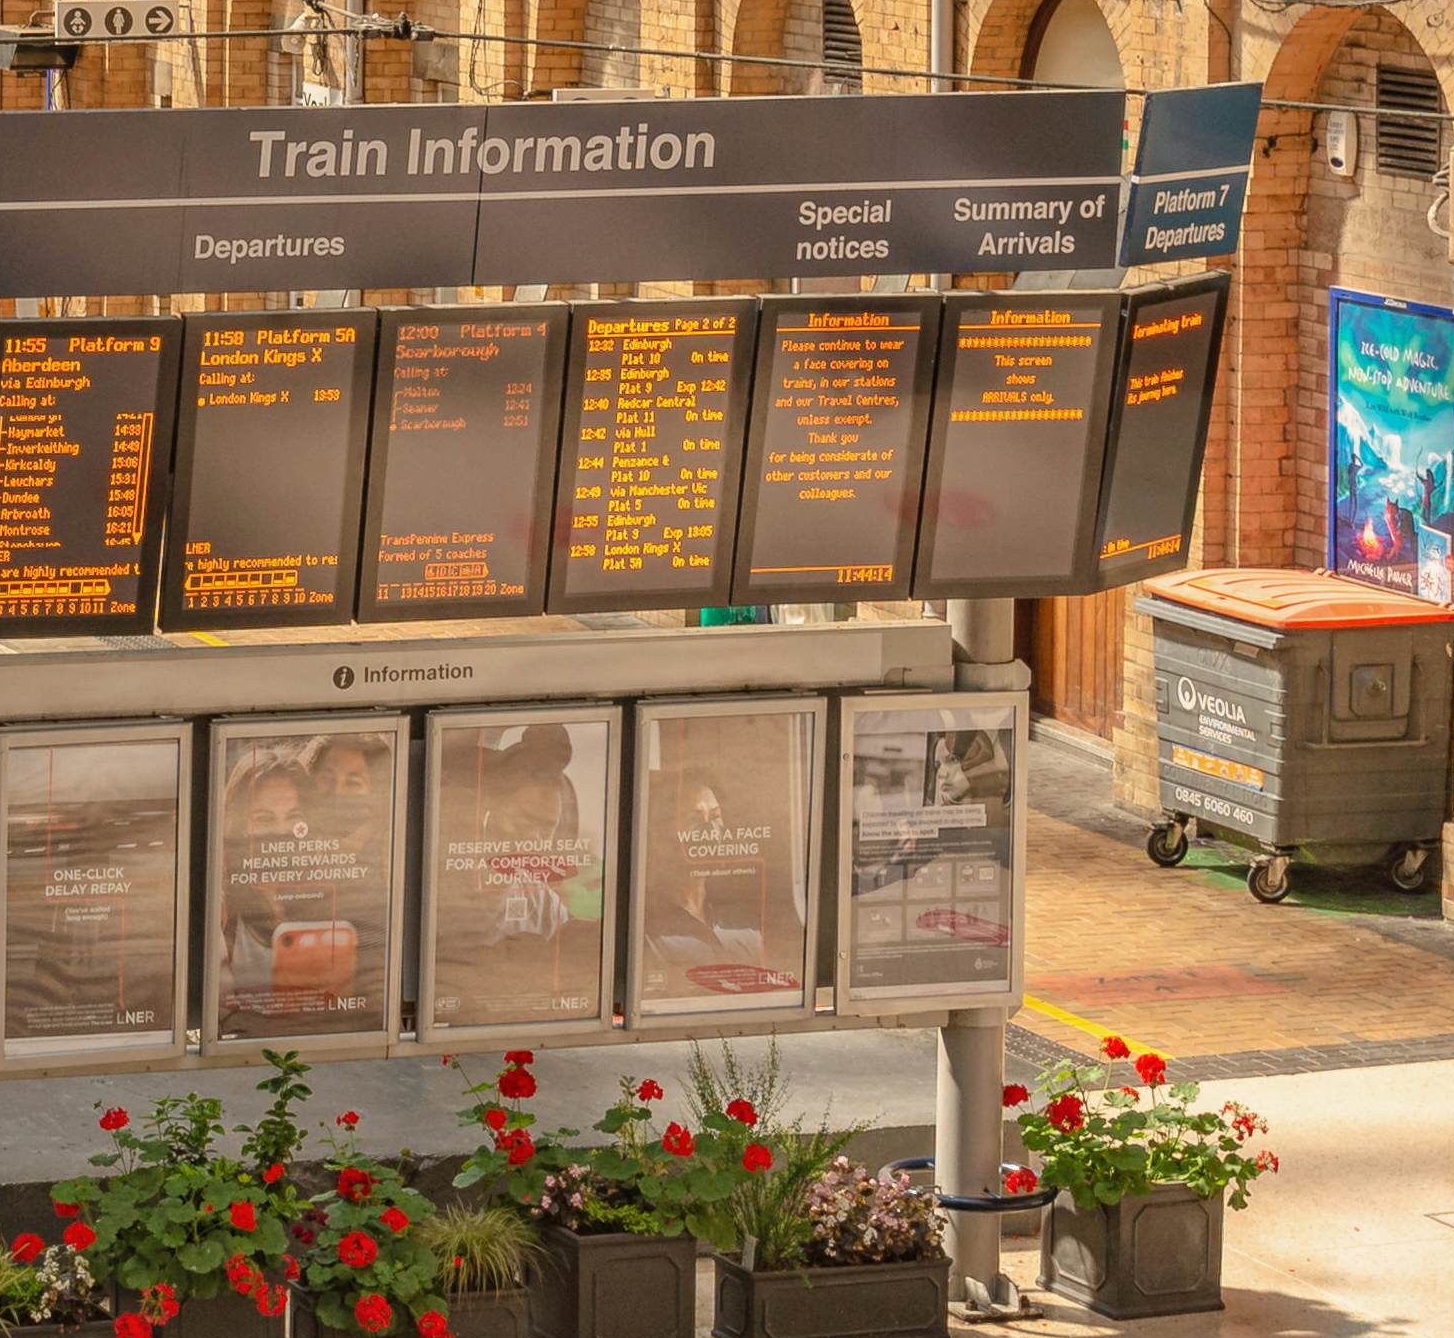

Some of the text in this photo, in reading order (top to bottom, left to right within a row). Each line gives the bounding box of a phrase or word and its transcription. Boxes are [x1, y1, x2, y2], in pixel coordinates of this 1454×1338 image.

[250, 123, 716, 179] Train Information
[1154, 184, 1229, 215] Platform 7
[799, 199, 891, 231] Special
[954, 194, 1105, 224] Summary of
[978, 231, 1076, 256] Arrivals
[1144, 220, 1225, 250] Departures
[195, 234, 345, 264] Departures
[796, 235, 889, 259] notices
[588, 317, 735, 335] Departures Page 2 of 2
[808, 313, 889, 327] Information
[991, 310, 1071, 324] Information
[5, 337, 160, 354] 11:55 Platform 9
[204, 328, 355, 346] 11:58 Platform 5A
[2, 359, 80, 373] Aberdeen
[201, 347, 322, 367] London Kings X
[1, 377, 90, 390] via Edinburgh
[365, 664, 473, 682] Information
[1197, 692, 1246, 724] VEOLIA
[1199, 714, 1256, 741] ENVIRONMENTAL
[1199, 725, 1232, 744] SERVICES
[1204, 798, 1230, 816] 6060
[1233, 807, 1253, 824] 460
[677, 826, 771, 843] WEAR A FACE
[261, 839, 339, 854] LNER PERKS
[448, 839, 591, 854] RESERVE YOUR SEAT
[688, 843, 758, 858] COVERING
[243, 853, 356, 870] MEANS REWARDS
[446, 854, 591, 870] FOR A COMFORTABLE
[54, 867, 124, 881] ONE-CLICK
[231, 867, 368, 885] FOR EVERY JOURNEY
[485, 872, 550, 885] JOURNEY
[45, 882, 132, 896] DELAY REPAY
